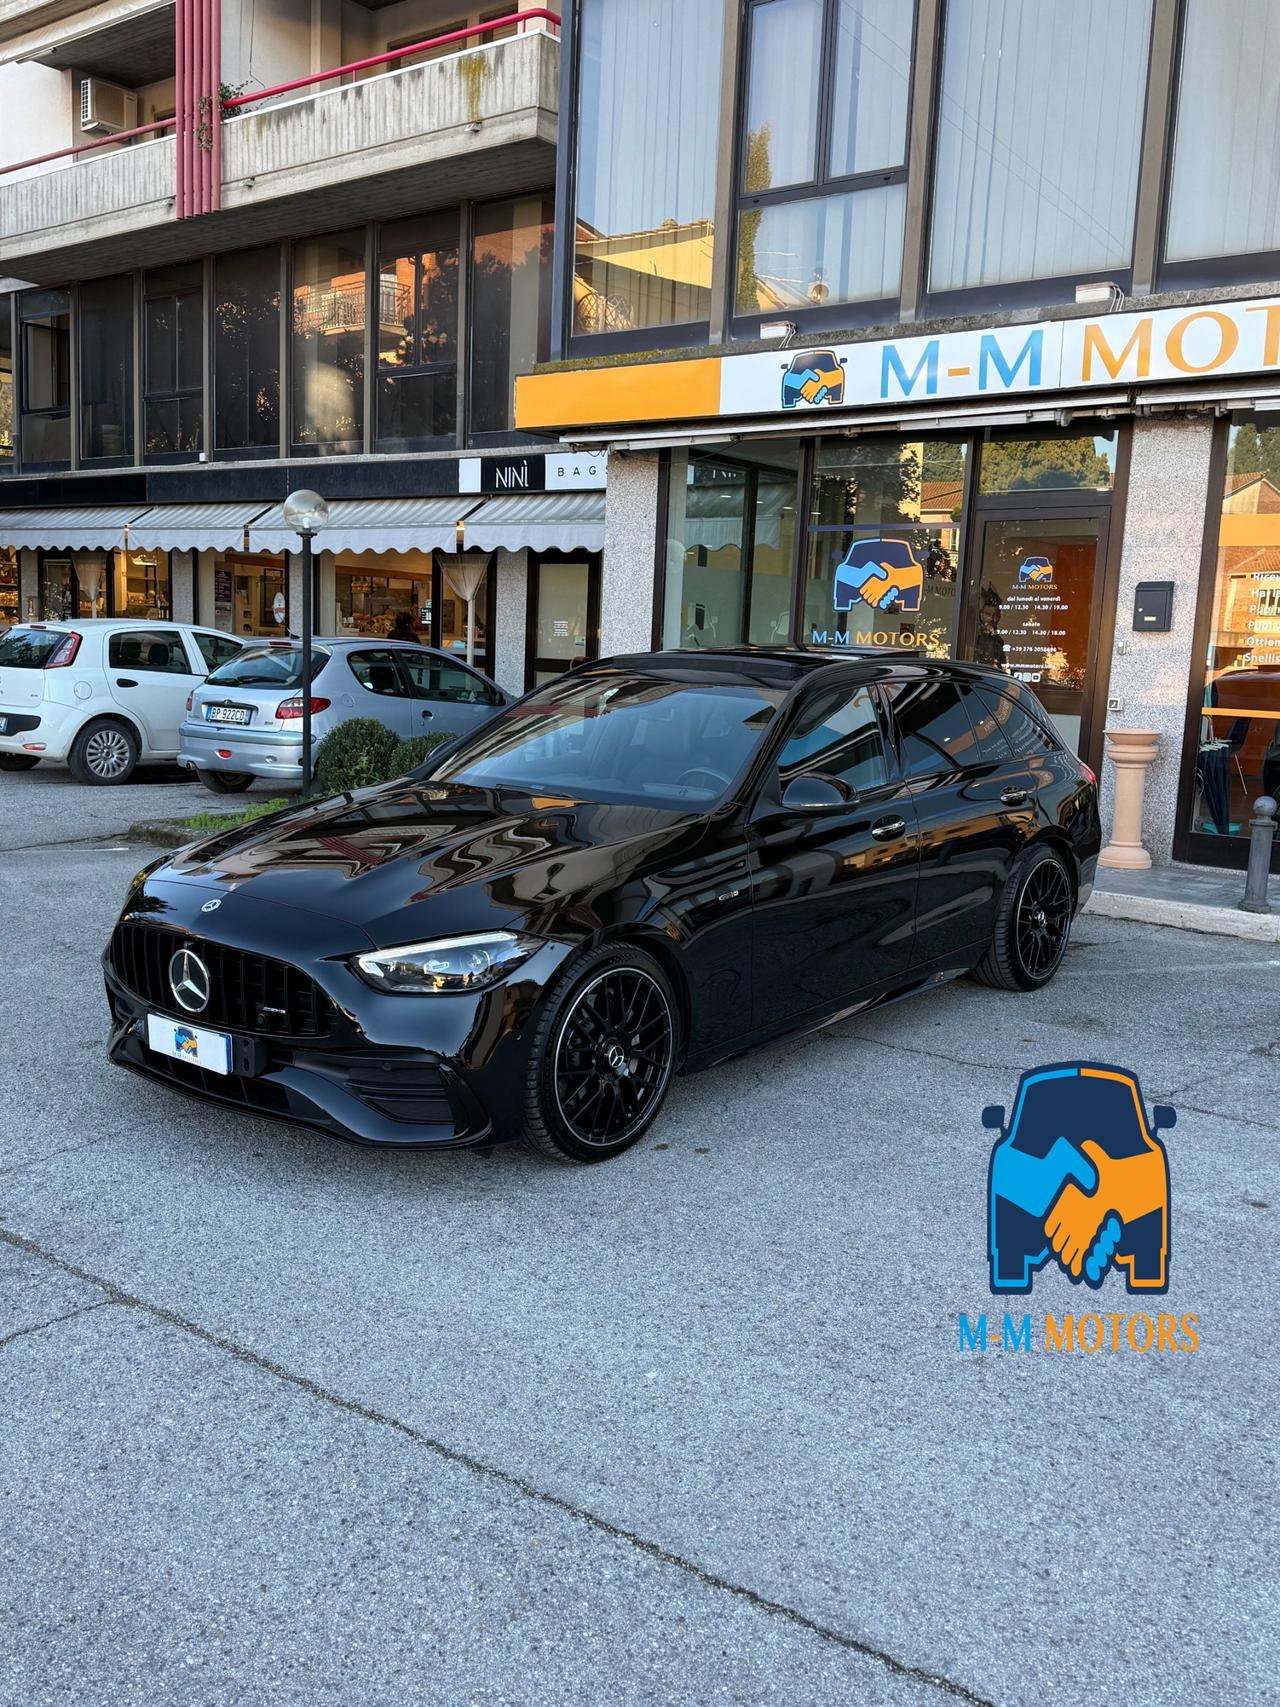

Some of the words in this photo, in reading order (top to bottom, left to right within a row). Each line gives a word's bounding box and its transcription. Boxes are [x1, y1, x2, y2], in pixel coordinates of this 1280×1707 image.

[880, 330, 1043, 398] M-M
[495, 460, 529, 489] NINÌ
[812, 630, 849, 645] M-M
[856, 631, 940, 647] MOTORS
[211, 708, 221, 719] BP
[221, 709, 245, 721] 922CD
